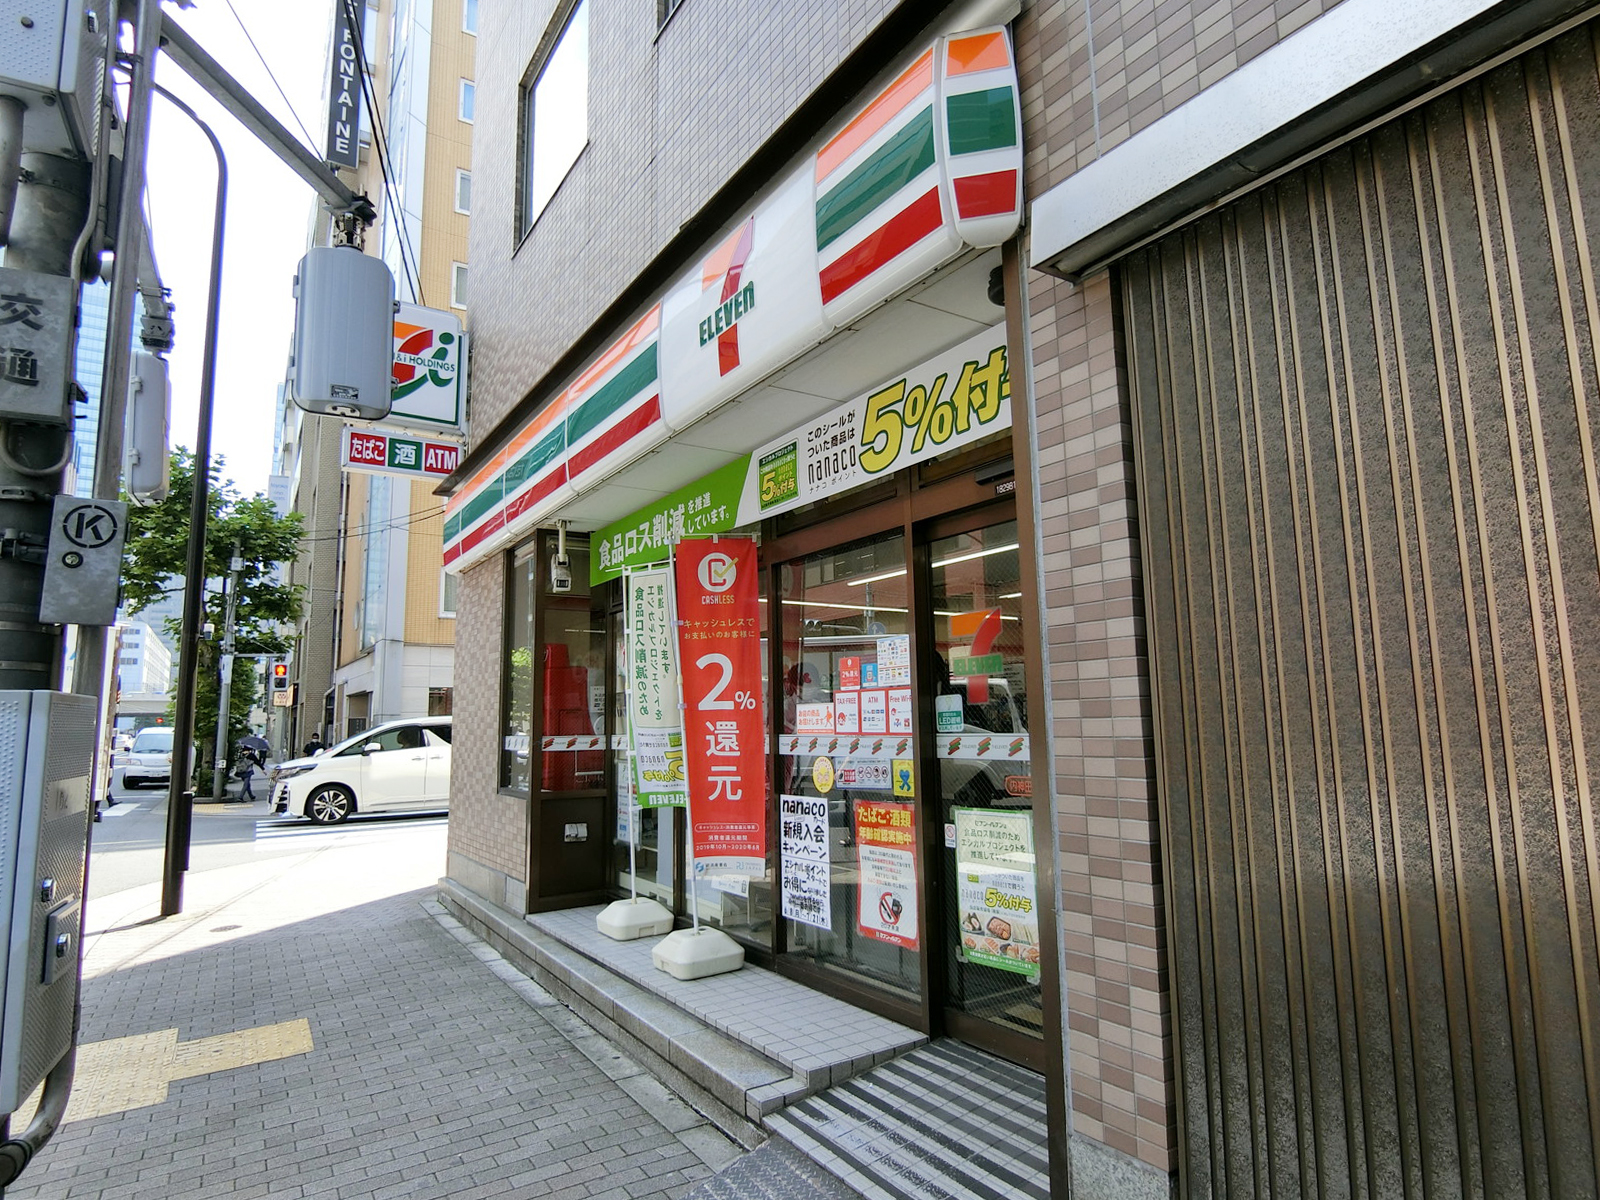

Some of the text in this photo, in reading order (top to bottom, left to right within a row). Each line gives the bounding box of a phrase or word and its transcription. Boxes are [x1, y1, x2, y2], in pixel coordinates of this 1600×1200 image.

[335, 28, 356, 155] FONTAINE
[0, 292, 44, 387] 交通
[409, 356, 456, 373] HOLDINGS
[858, 344, 1011, 474] 5%付
[807, 409, 856, 443] このシールが
[350, 437, 386, 462] たばこ
[394, 442, 418, 466] 酒
[807, 427, 856, 459] ついた商品は
[426, 448, 457, 470] ATM
[807, 444, 857, 485] nanaco
[687, 491, 712, 515] を推進
[687, 504, 730, 534] しています。
[599, 503, 687, 571] 食品ロス削減
[701, 594, 735, 605] CASHLESS
[683, 617, 755, 629] キャッシュレスで
[684, 630, 756, 641] お支払いのお客様に
[695, 652, 757, 711] 2%
[867, 696, 879, 704] ATM
[889, 695, 900, 703] Free
[705, 720, 743, 801] 還元
[782, 798, 826, 817] nanaco
[783, 820, 825, 843] 新規入会
[782, 840, 827, 859] キャンペーン
[961, 838, 1026, 853] エシカルプロジェクトを
[984, 887, 1033, 913] 5%付与
